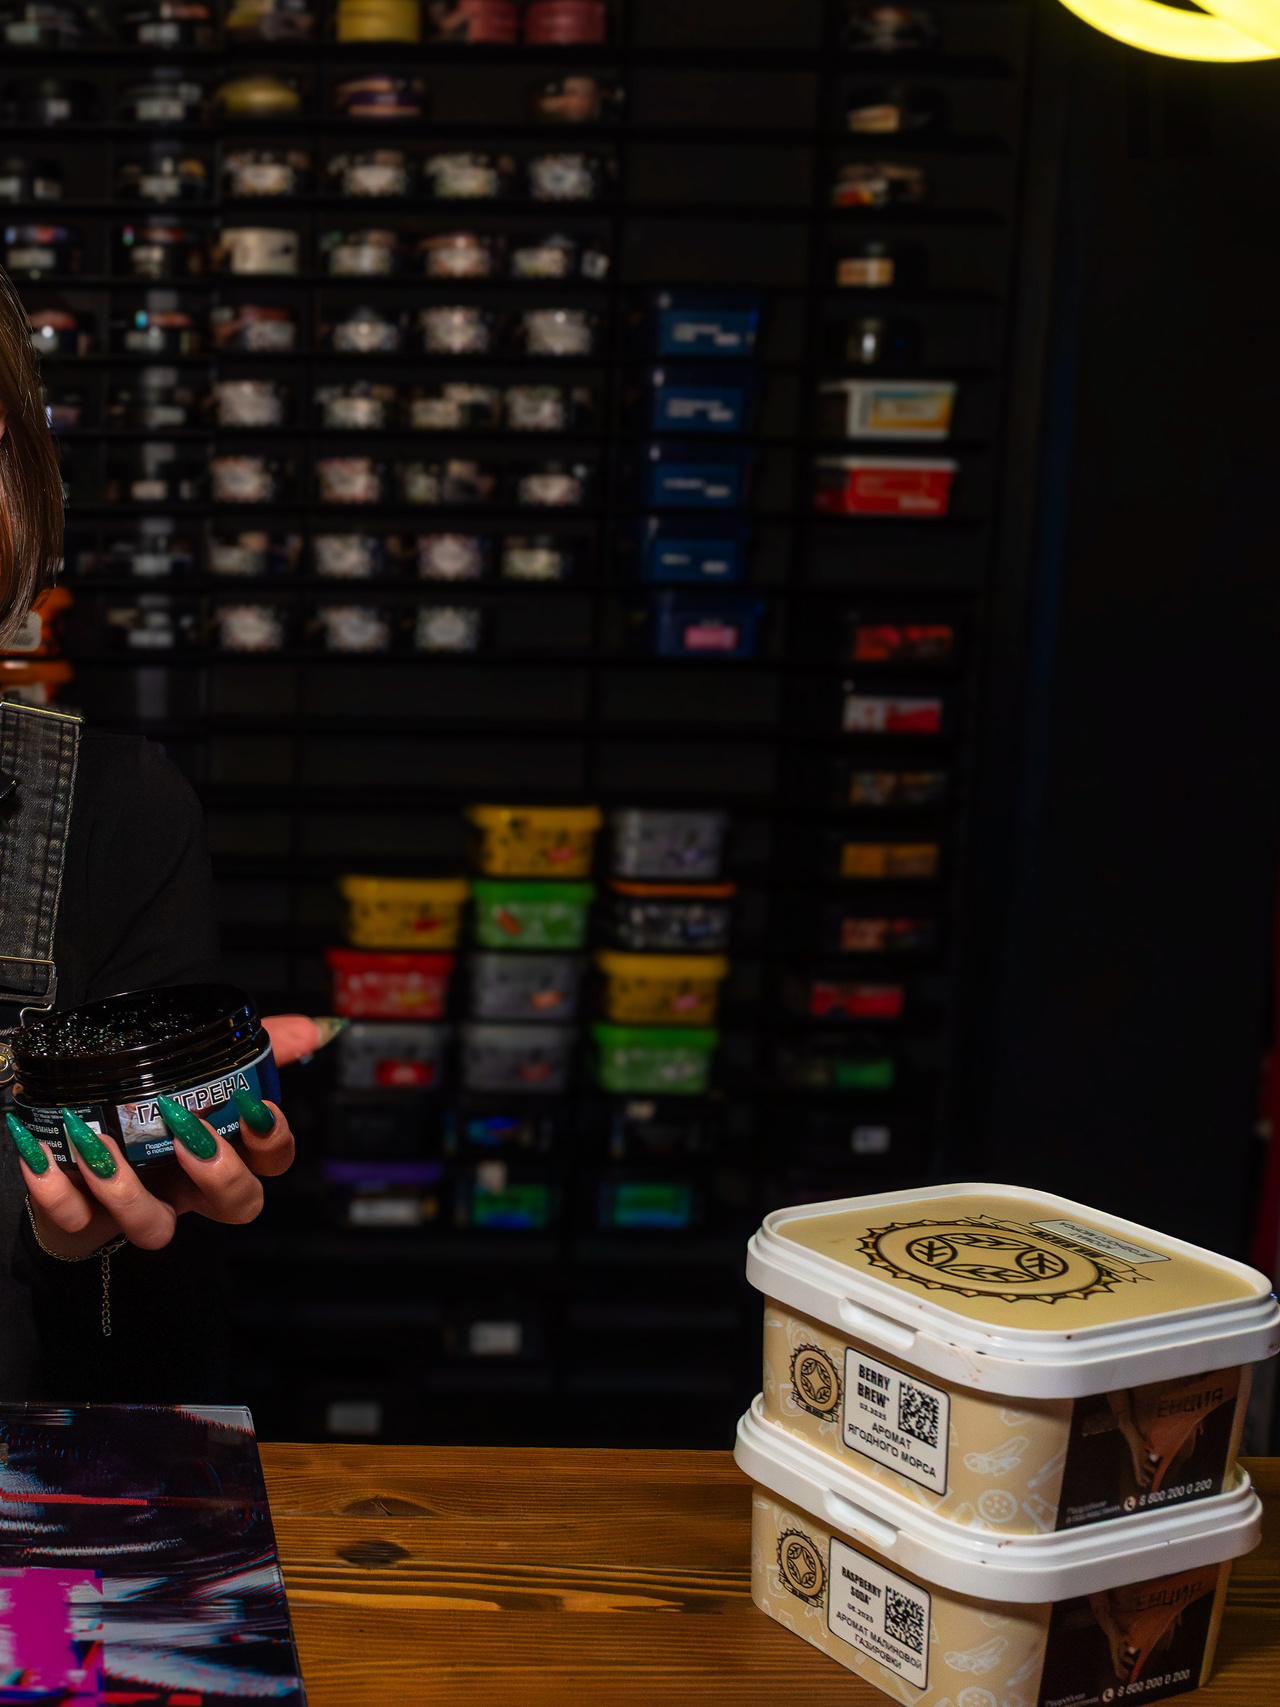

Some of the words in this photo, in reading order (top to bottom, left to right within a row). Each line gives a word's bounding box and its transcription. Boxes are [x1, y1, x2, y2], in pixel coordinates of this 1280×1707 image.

[136, 1072, 250, 1125] ГАГРЕНА
[216, 1126, 226, 1136] 00
[227, 1121, 240, 1132] 200
[858, 1363, 891, 1391] BERRY
[848, 1423, 899, 1457] ЯГОДНОГО
[901, 1451, 937, 1478] МОРСА
[871, 1422, 912, 1450] АРОМАТ
[841, 1566, 882, 1598] RASPBERRY
[836, 1611, 869, 1636] АРОМАТ
[869, 1631, 922, 1670] МАЛИНОВОЙ
[855, 1634, 901, 1670] ГАЗИРОВКИ
